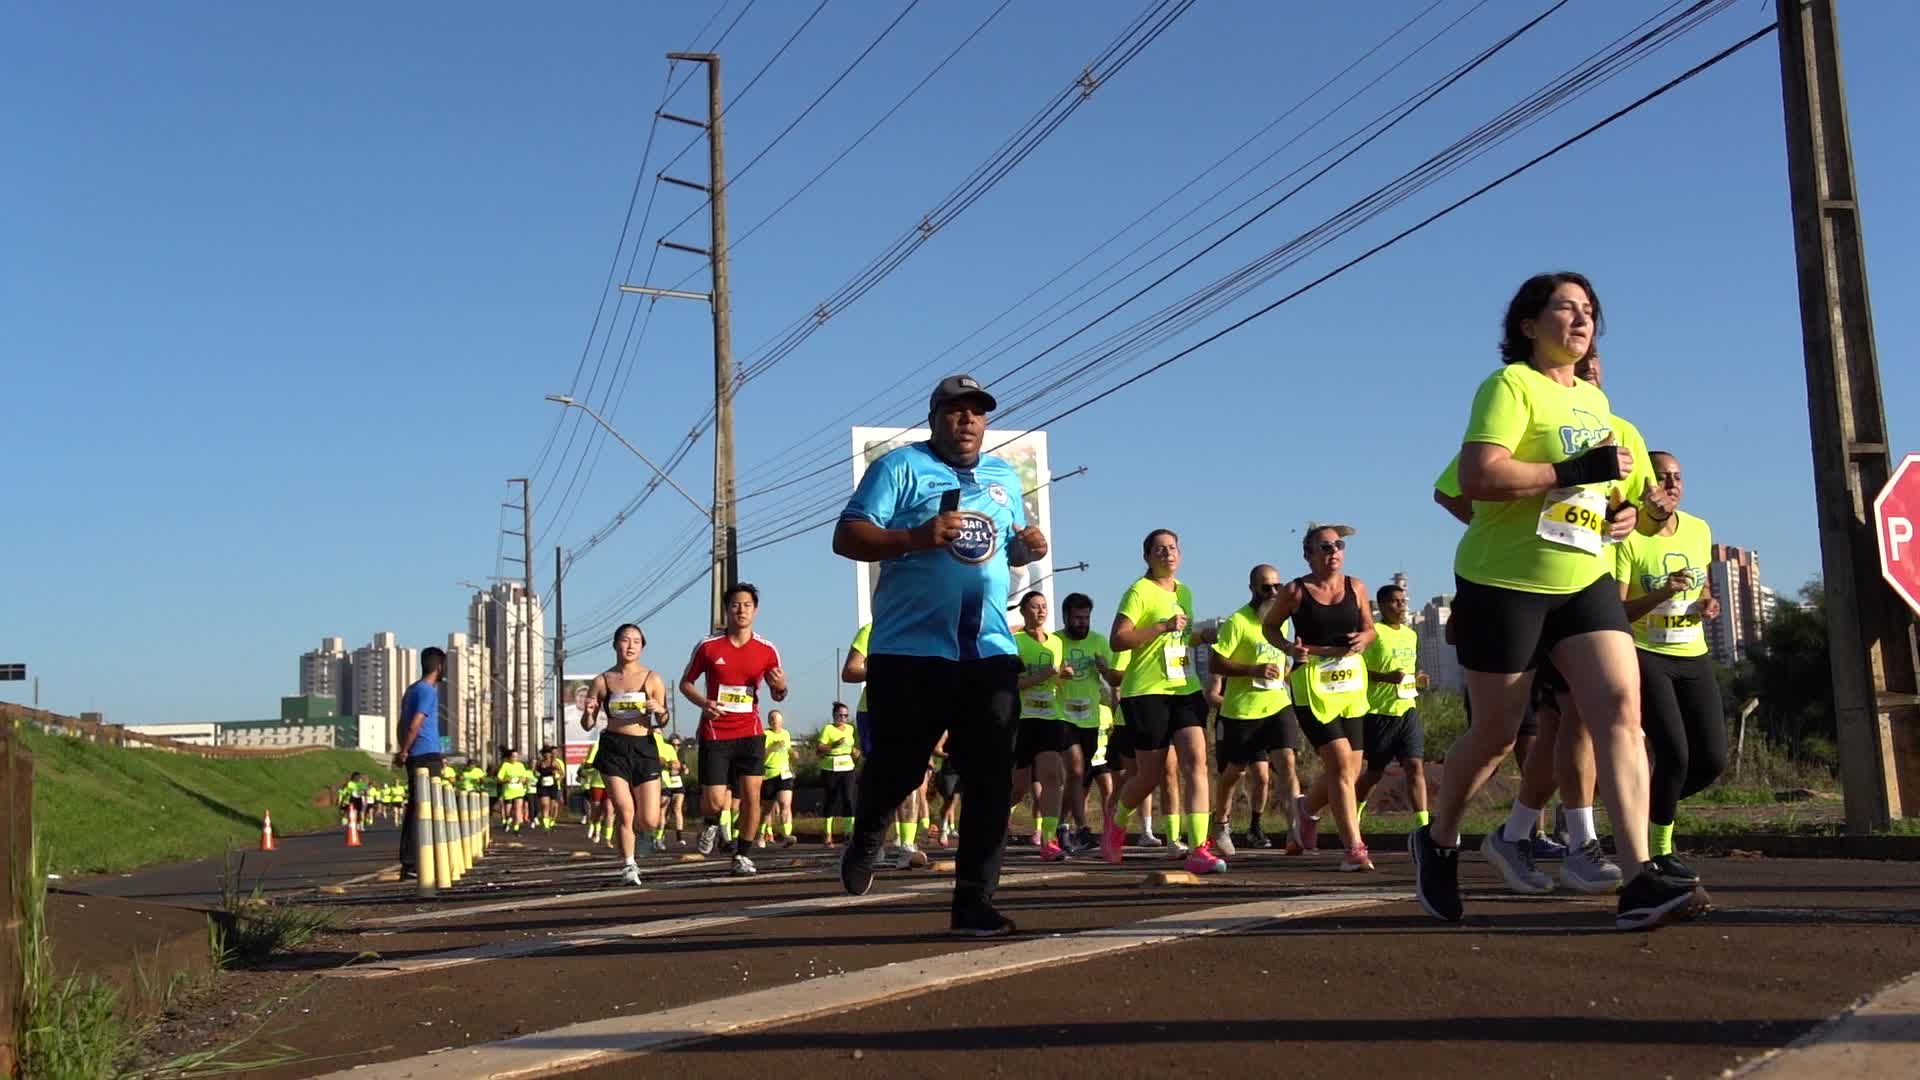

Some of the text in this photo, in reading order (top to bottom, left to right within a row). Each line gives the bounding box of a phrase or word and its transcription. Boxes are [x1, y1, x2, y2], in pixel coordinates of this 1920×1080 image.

[1565, 506, 1597, 531] 696
[1664, 615, 1694, 628] 1125
[1331, 669, 1352, 681] 699
